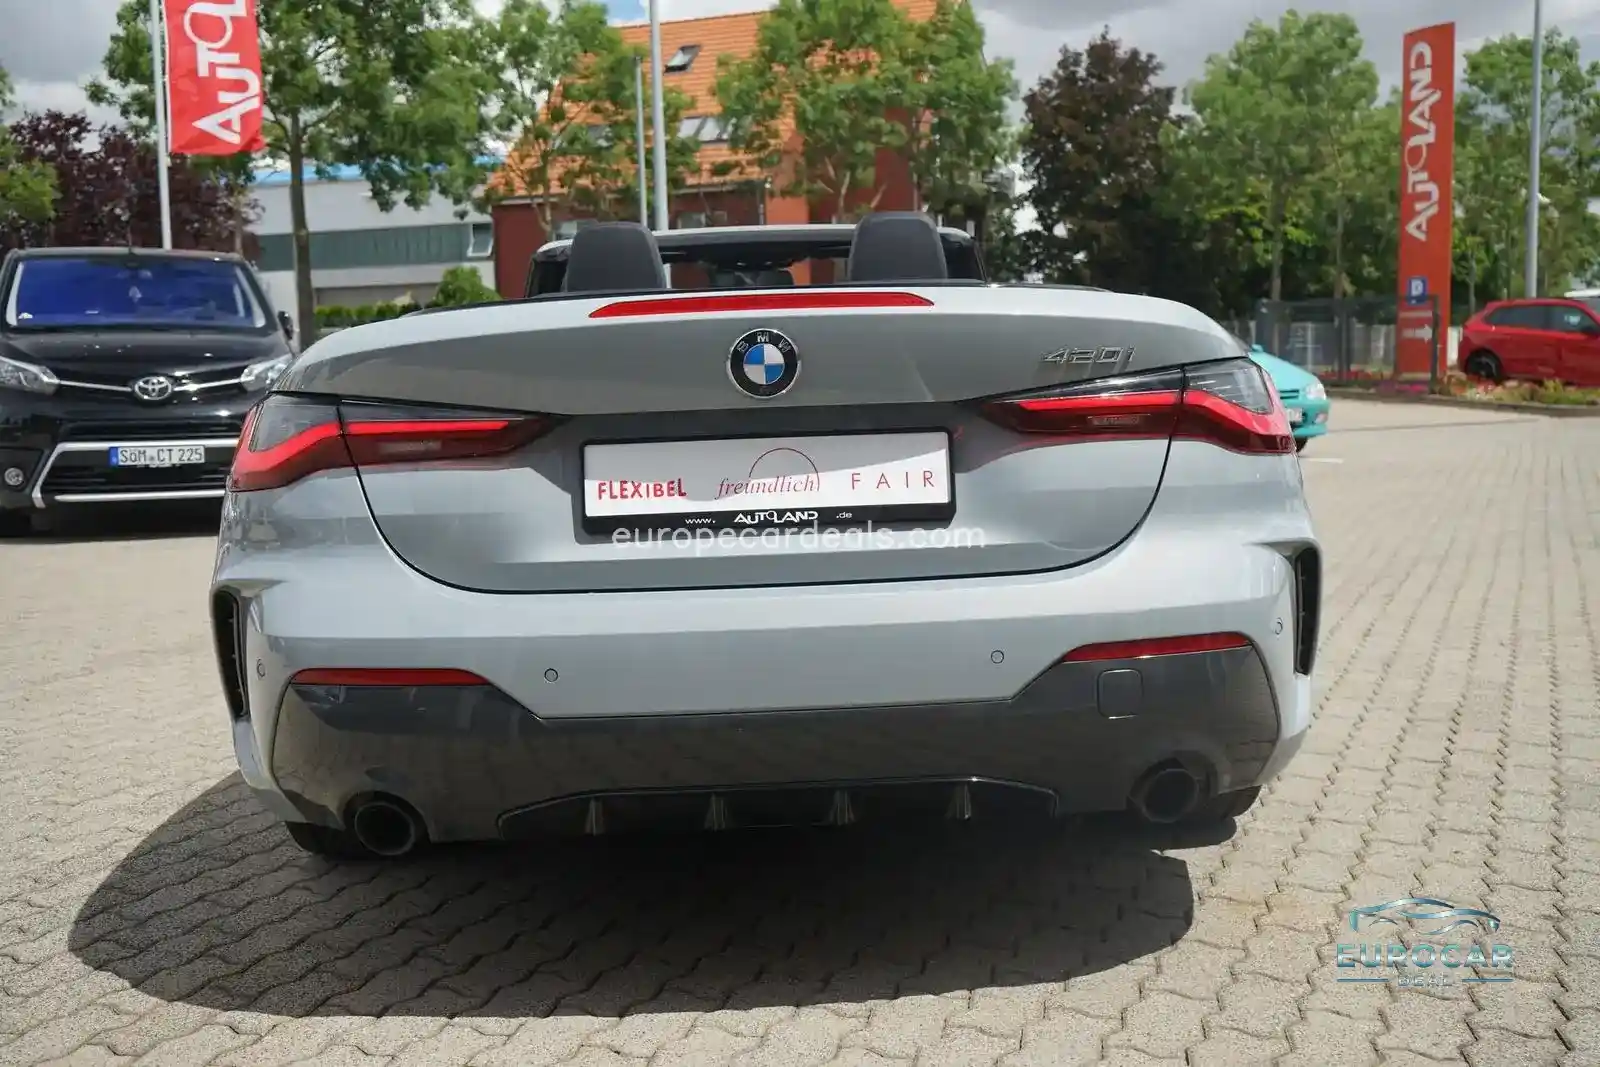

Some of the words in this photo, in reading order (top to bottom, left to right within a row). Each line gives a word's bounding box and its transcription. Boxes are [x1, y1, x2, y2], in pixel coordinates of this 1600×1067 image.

[1404, 41, 1442, 242] AUTOLAND
[736, 331, 792, 354] BMW
[1040, 344, 1137, 364] 420i
[157, 448, 174, 463] CT
[178, 447, 203, 462] 225
[597, 478, 688, 501] FLEXIBEL
[714, 475, 815, 500] freundlich
[851, 470, 935, 491] FAIR
[685, 517, 716, 525] www.
[734, 510, 819, 525] AUTOLAND
[836, 511, 853, 519] .de
